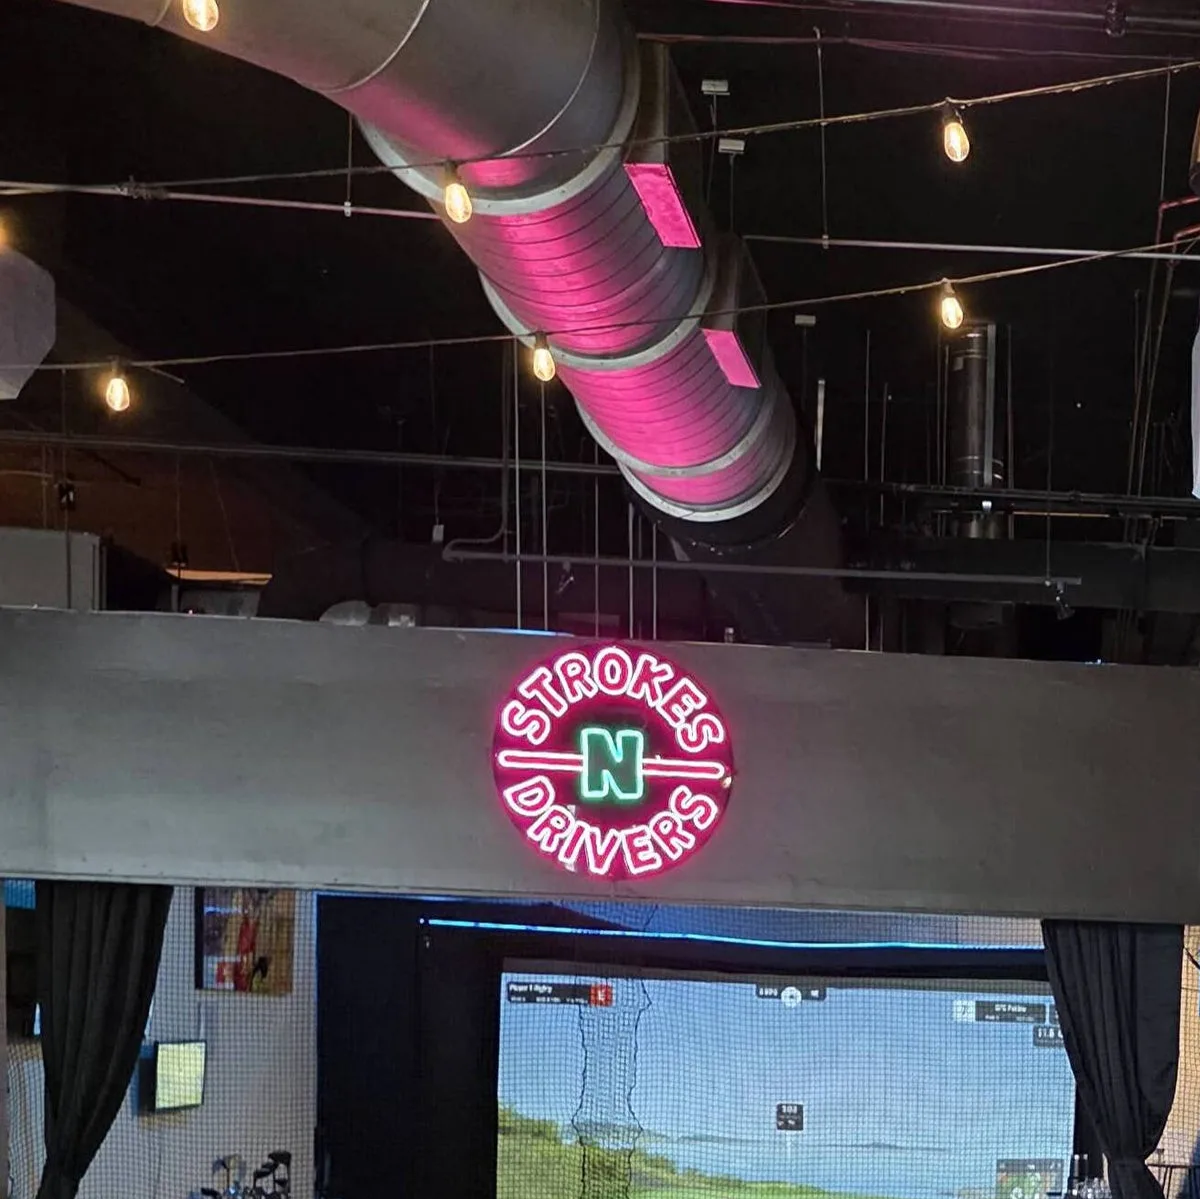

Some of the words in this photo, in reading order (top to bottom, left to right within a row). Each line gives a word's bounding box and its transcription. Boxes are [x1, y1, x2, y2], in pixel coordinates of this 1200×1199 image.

[502, 646, 724, 753] STROKES
[580, 727, 643, 800] N
[503, 774, 719, 875] DRIVERS
